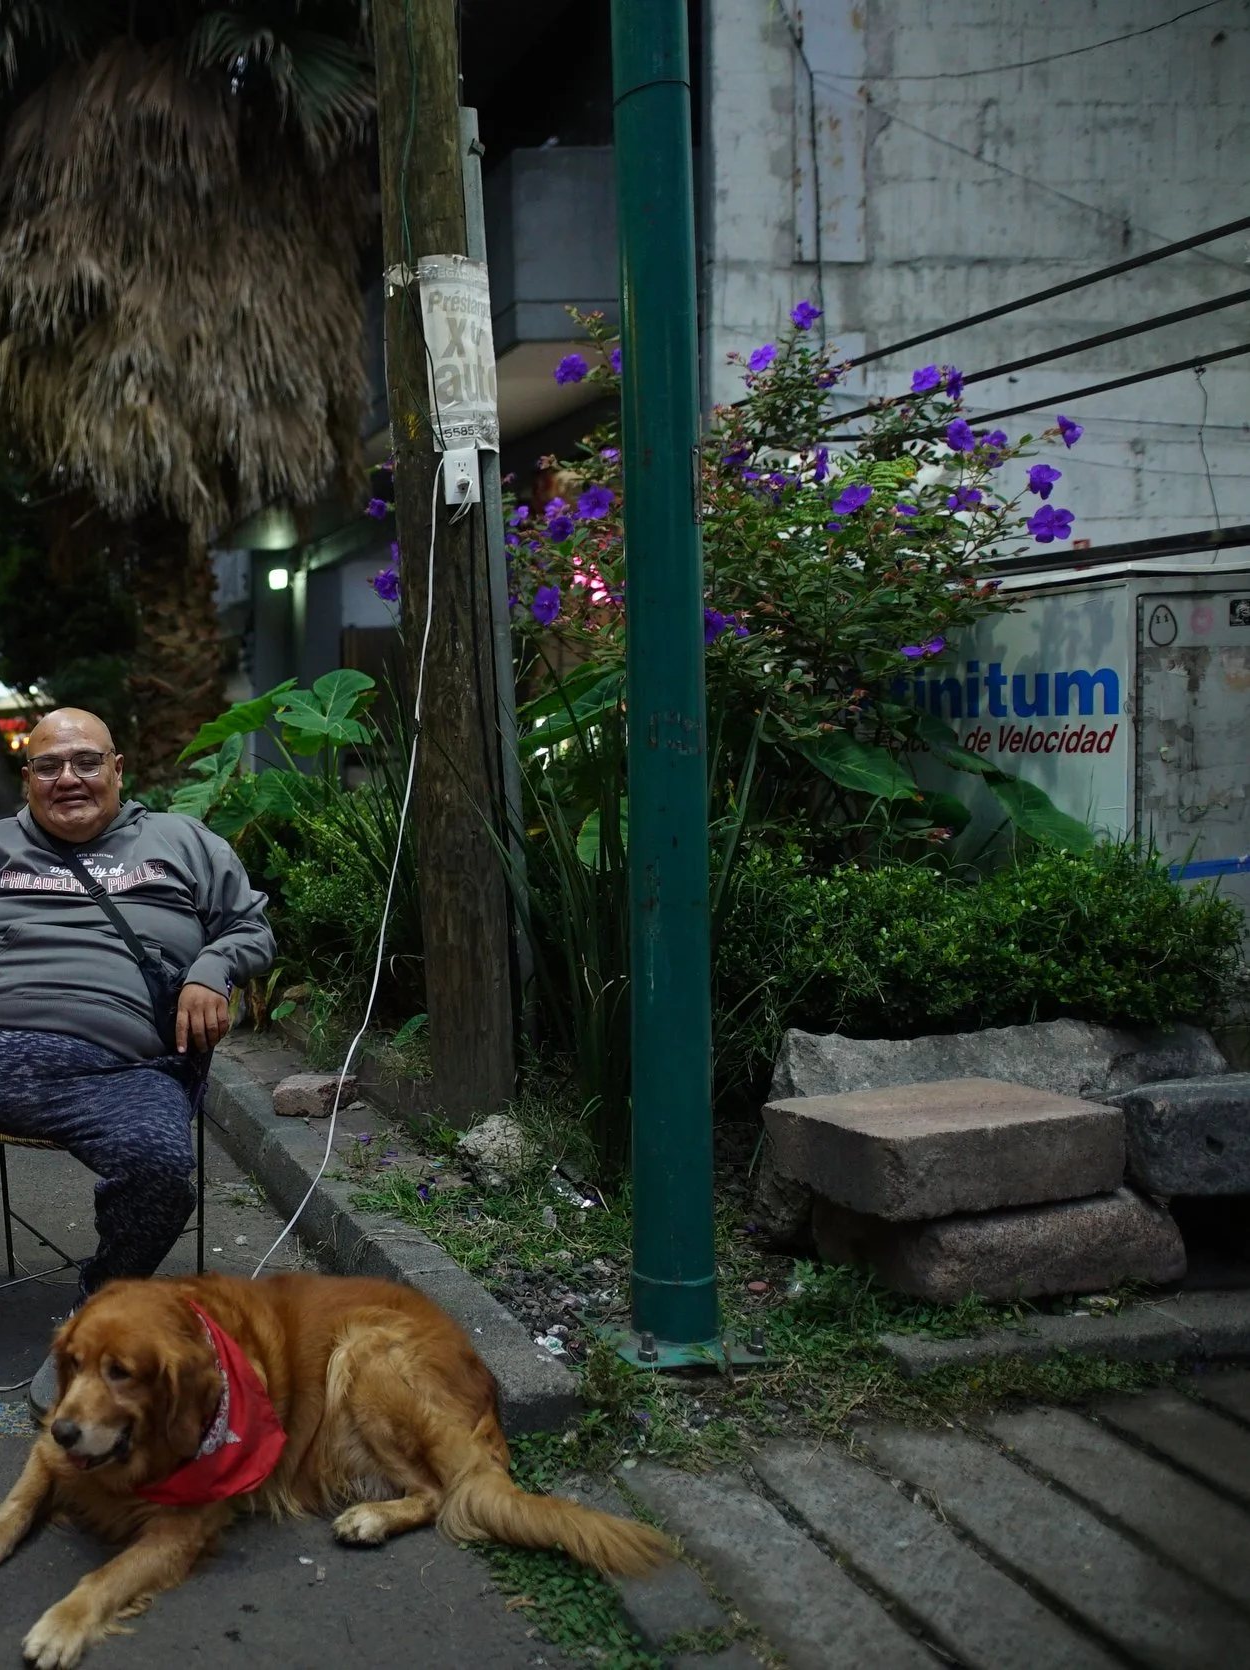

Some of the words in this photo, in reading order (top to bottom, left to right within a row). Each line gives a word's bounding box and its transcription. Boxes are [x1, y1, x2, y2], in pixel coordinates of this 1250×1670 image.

[963, 725, 992, 753] de
[997, 723, 1119, 755] Velocidad
[49, 864, 109, 879] Prorty
[109, 862, 125, 876] of
[107, 861, 167, 893] PHILLIES
